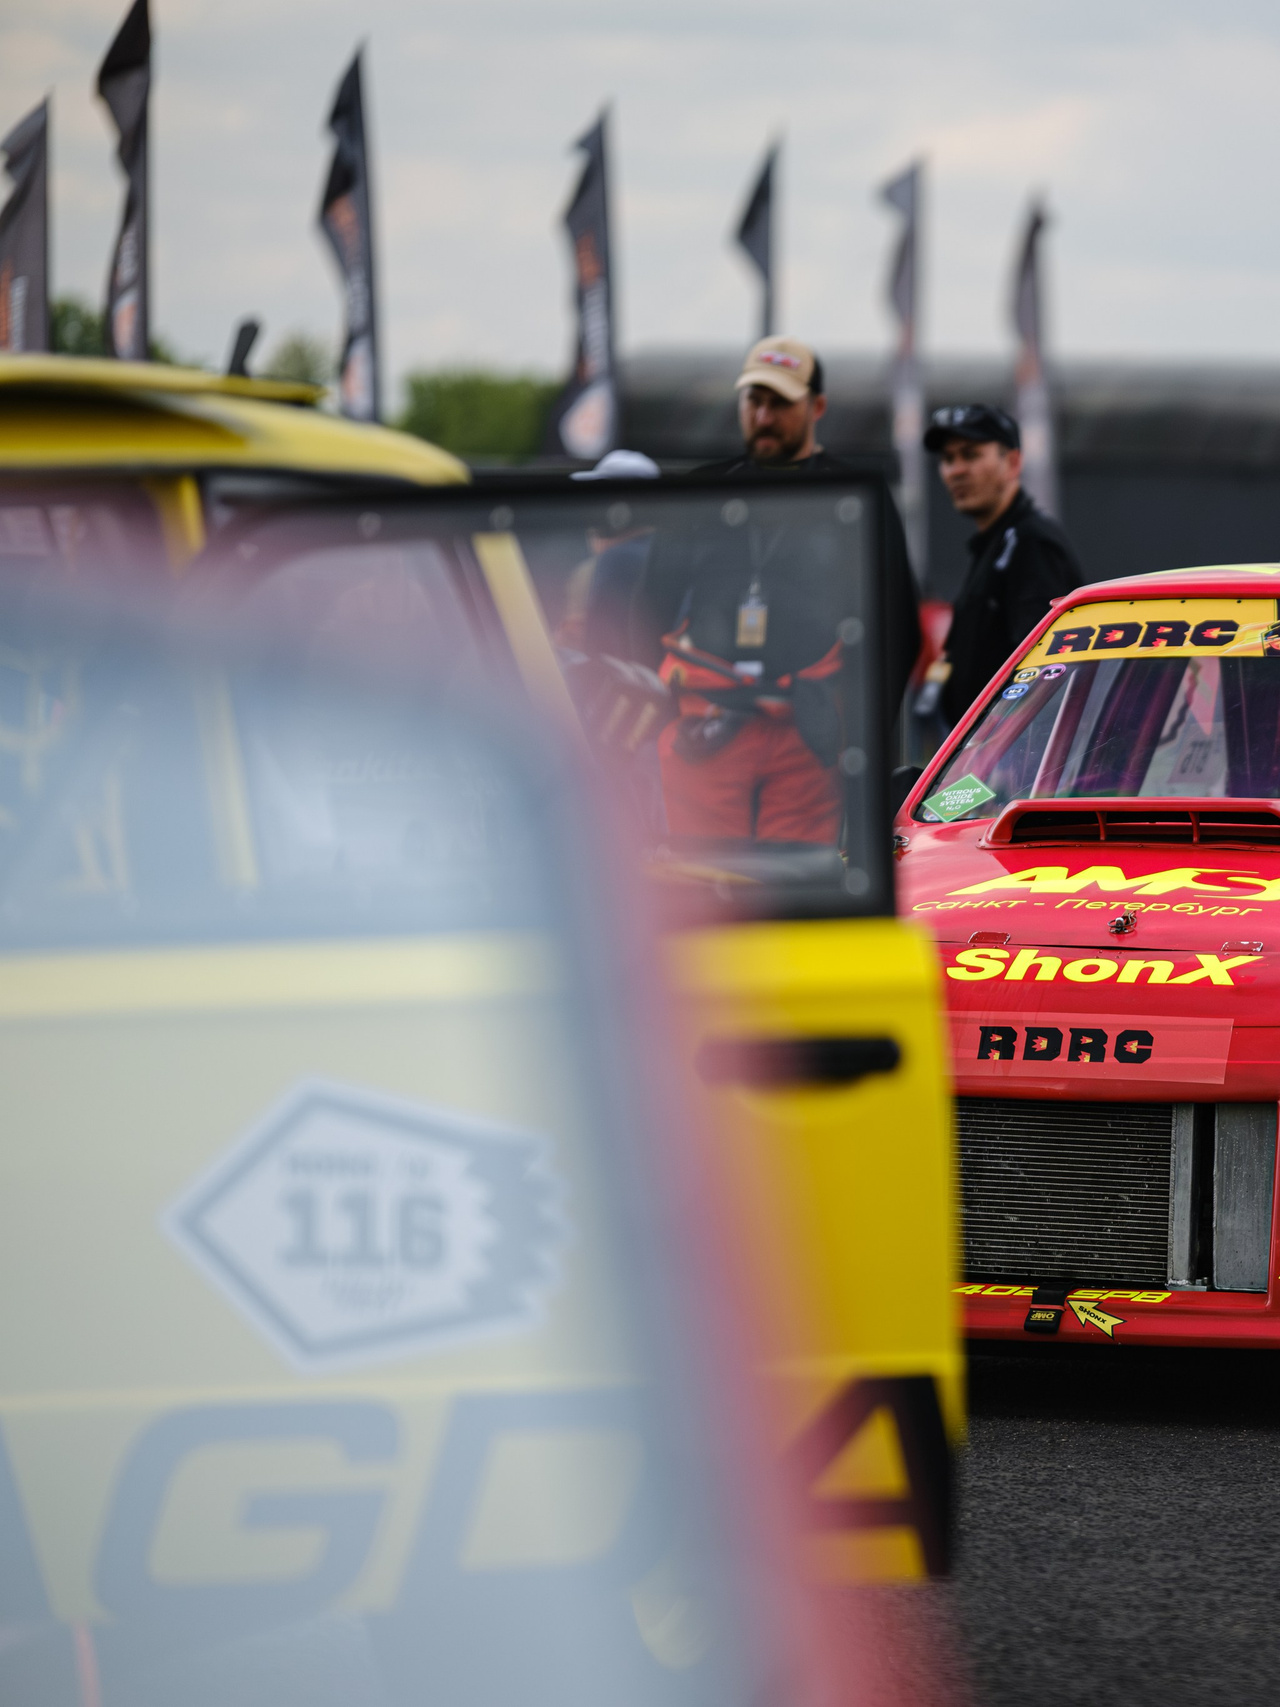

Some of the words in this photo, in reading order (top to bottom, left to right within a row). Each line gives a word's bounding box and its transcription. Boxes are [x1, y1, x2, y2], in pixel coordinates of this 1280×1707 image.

[1046, 620, 1240, 656] RDRC
[942, 788, 982, 797] NITROUS
[939, 798, 974, 807] SYSTEM
[1055, 899, 1263, 917] Петербург
[946, 948, 1264, 986] ShonX
[977, 1026, 1154, 1064] RDRC
[280, 1187, 450, 1270] 116
[1067, 1289, 1172, 1303] SPB
[1078, 1305, 1107, 1324] SHONX
